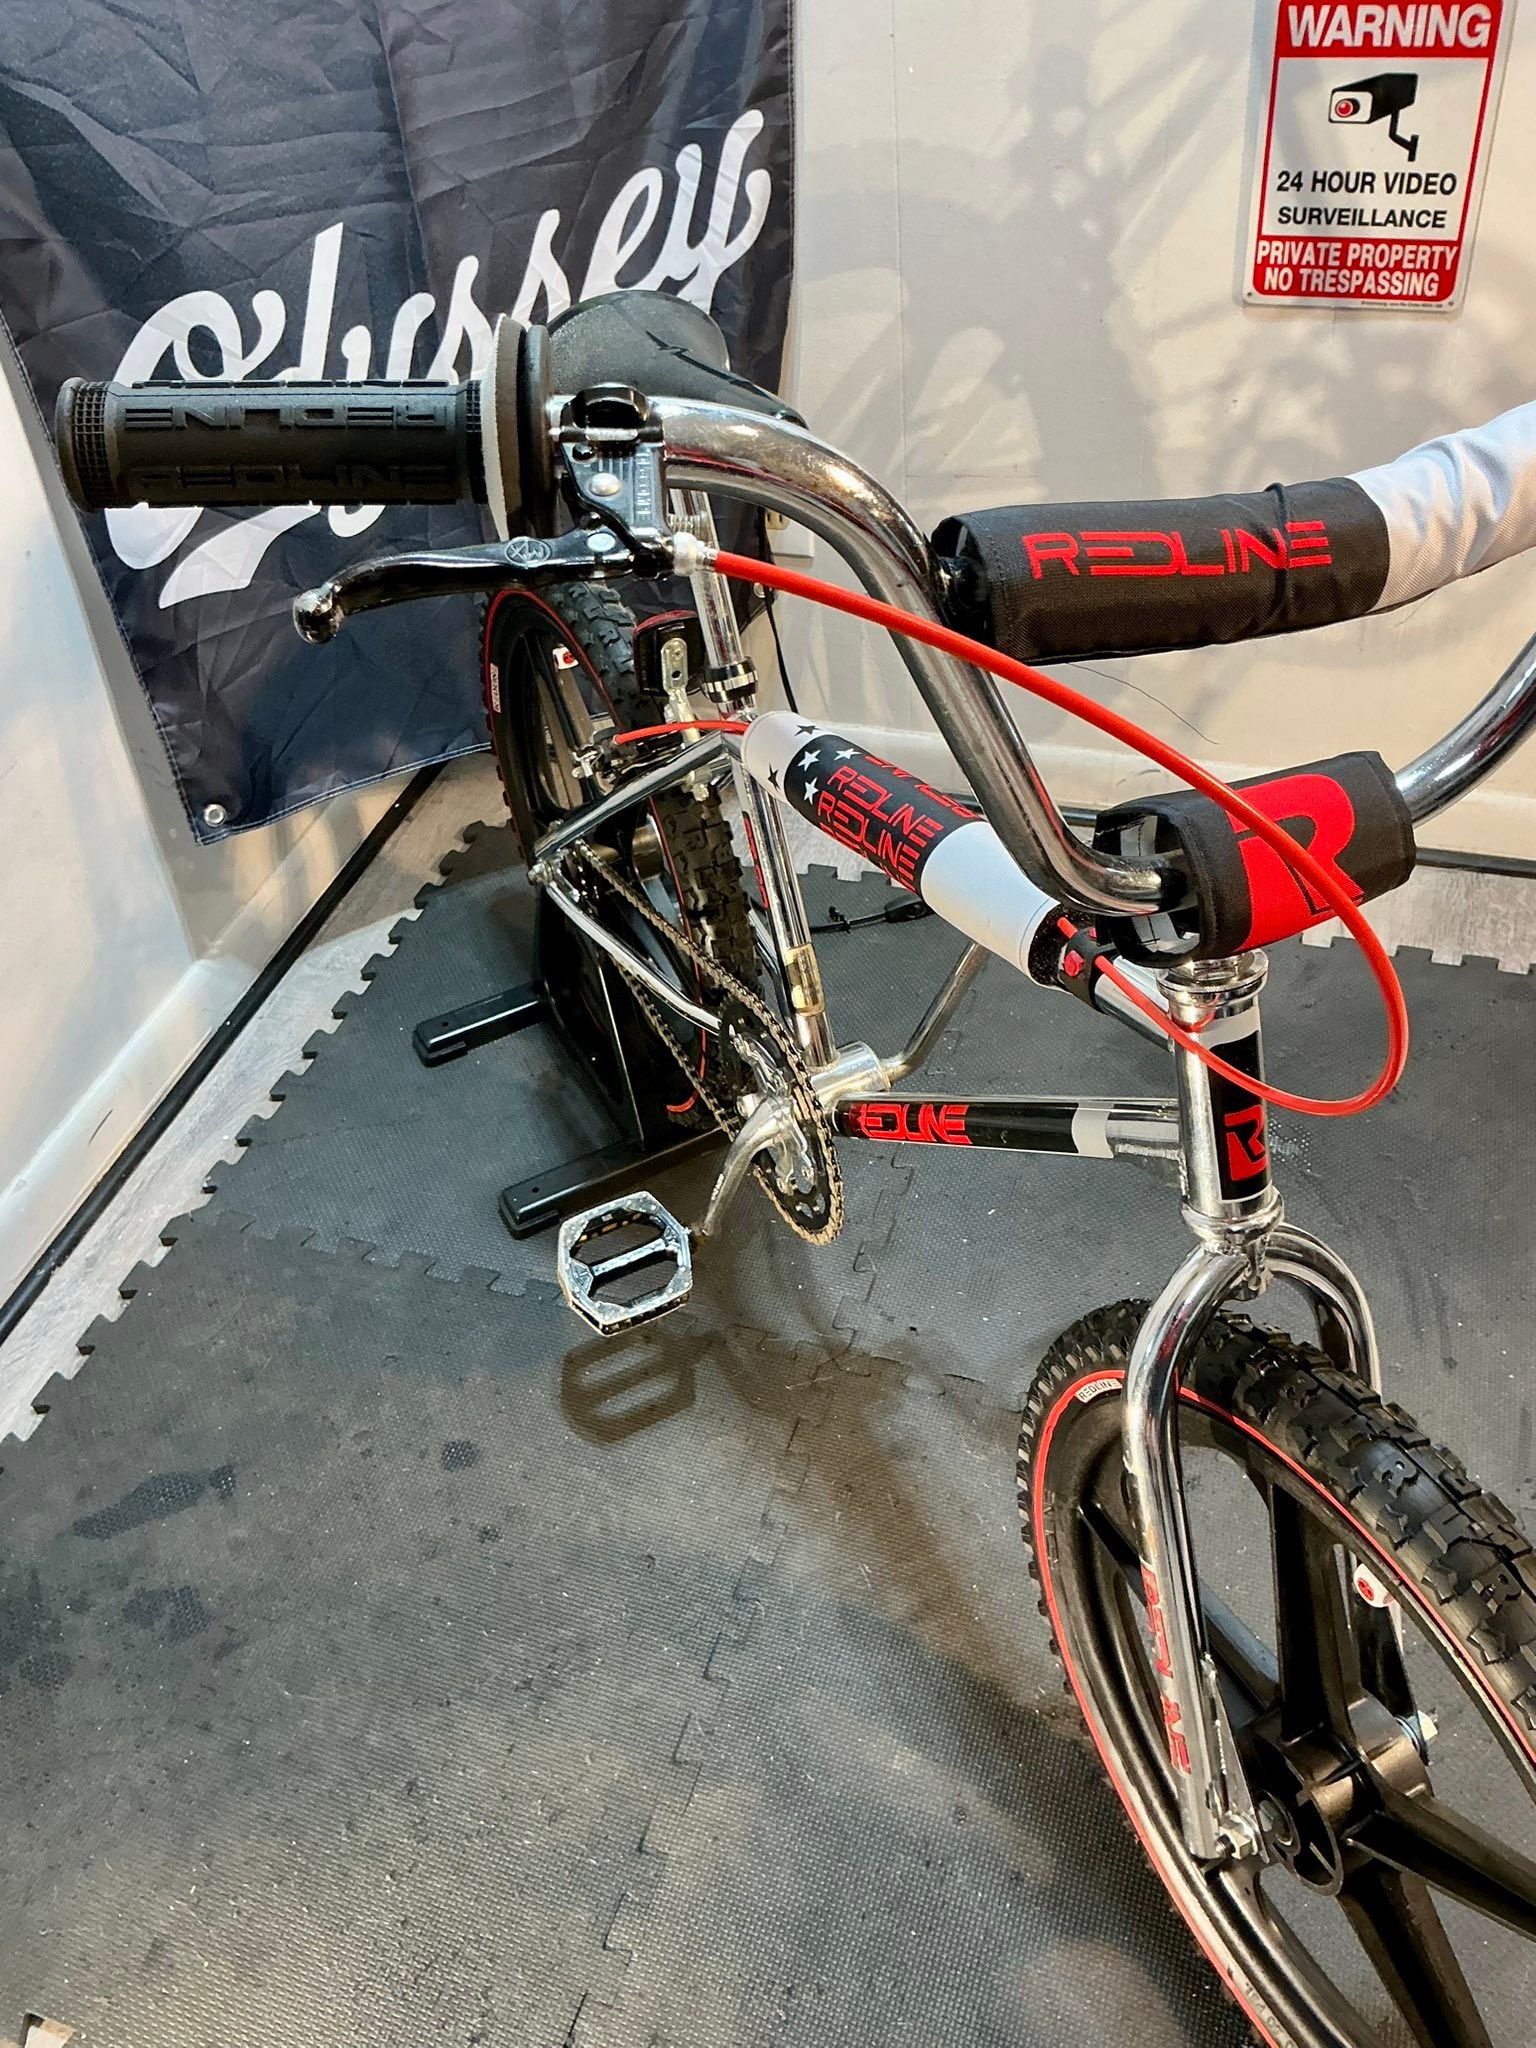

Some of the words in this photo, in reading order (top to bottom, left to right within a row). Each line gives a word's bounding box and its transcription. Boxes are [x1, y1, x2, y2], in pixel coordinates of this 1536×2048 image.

[1288, 3, 1492, 48] WARNING
[1276, 170, 1303, 192] 24
[1311, 171, 1376, 194] HOUR
[1384, 172, 1457, 195] VIDEO
[1278, 206, 1448, 228] SURVEILLANCE
[1257, 240, 1341, 267] PRIVATE
[1346, 243, 1459, 271] PROPERTY
[1264, 267, 1294, 291] NO
[1299, 270, 1440, 297] TRESPASSING
[1022, 520, 1332, 580] REDLINE
[827, 765, 945, 849] REDLINE
[816, 790, 921, 881] REDLINE
[1078, 1380, 1119, 1400] REDLINE
